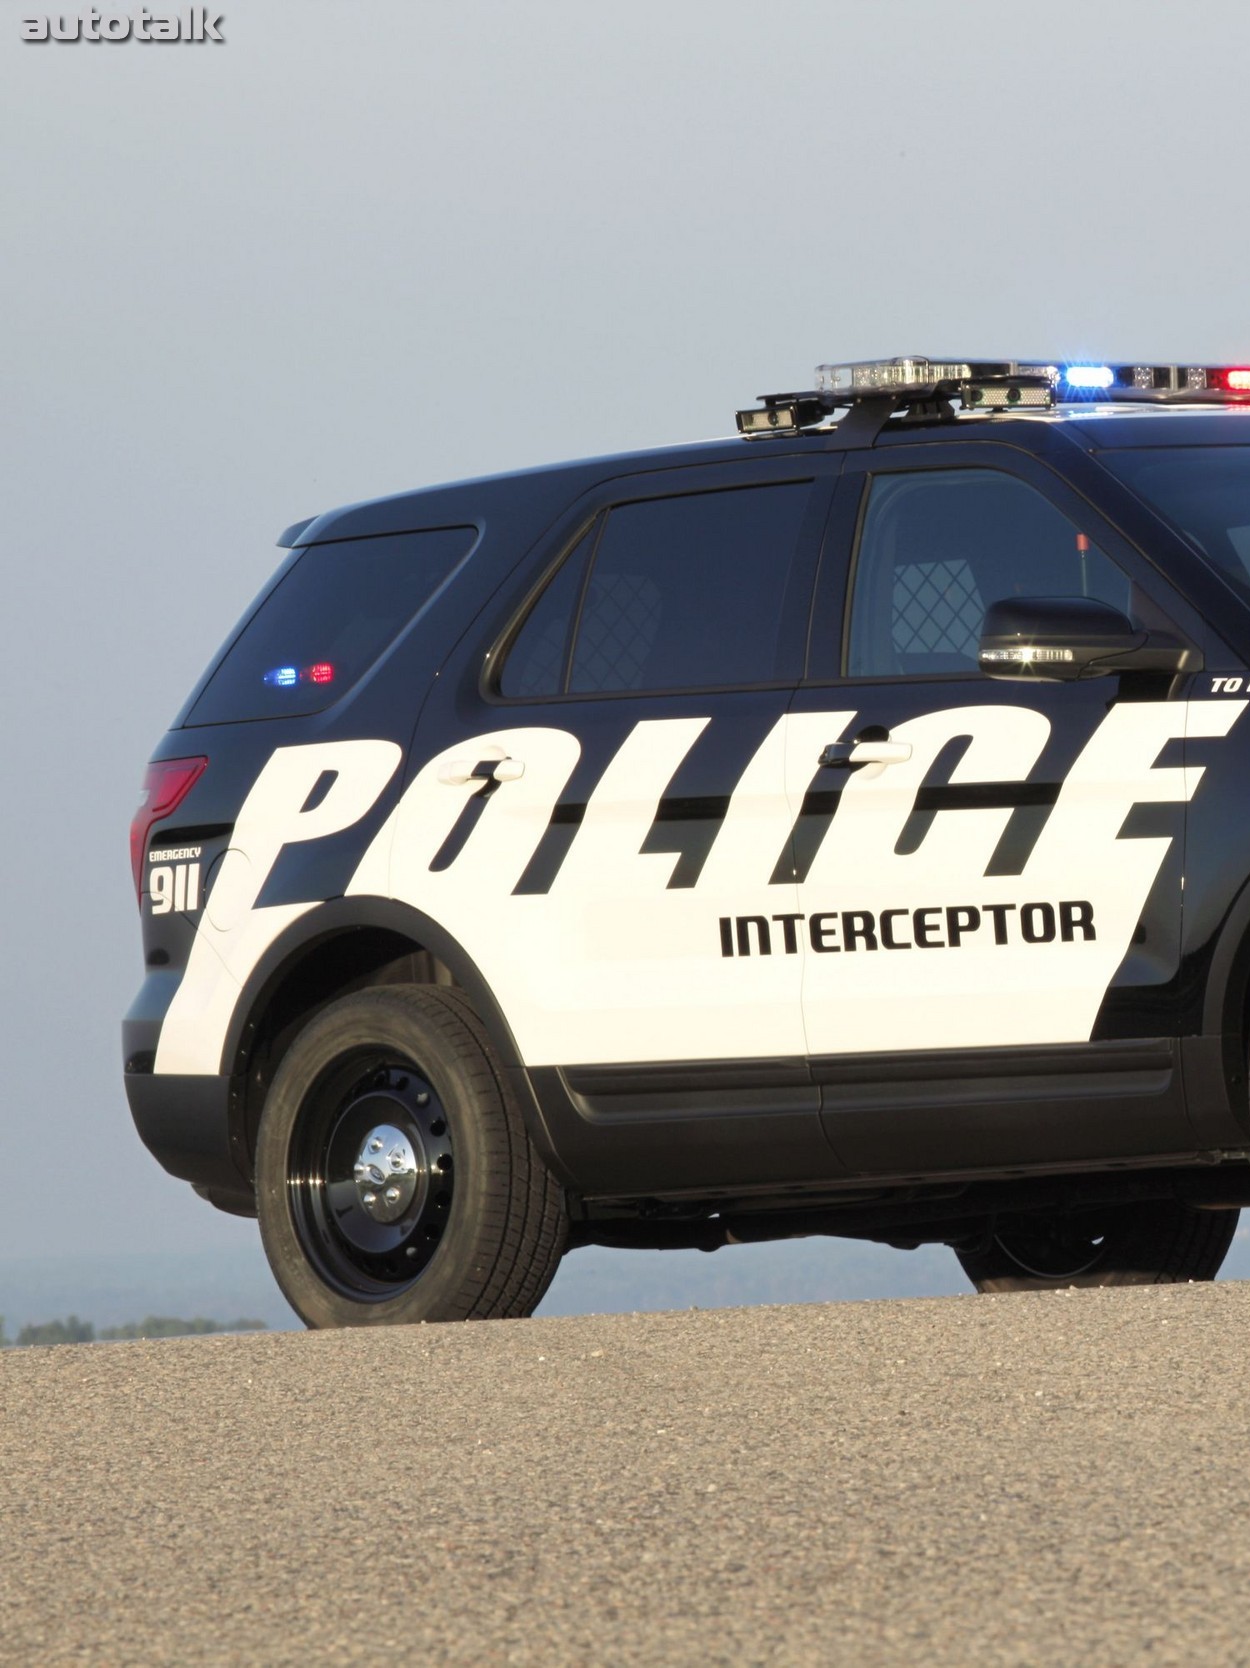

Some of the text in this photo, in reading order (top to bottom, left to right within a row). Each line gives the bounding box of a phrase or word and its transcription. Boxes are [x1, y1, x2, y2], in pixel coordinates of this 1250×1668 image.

[1211, 677, 1244, 693] TO
[190, 699, 1250, 935] POLICE
[149, 846, 202, 863] EMERGENCY
[149, 863, 200, 915] 911
[718, 899, 1097, 958] INTERCEPTOR
